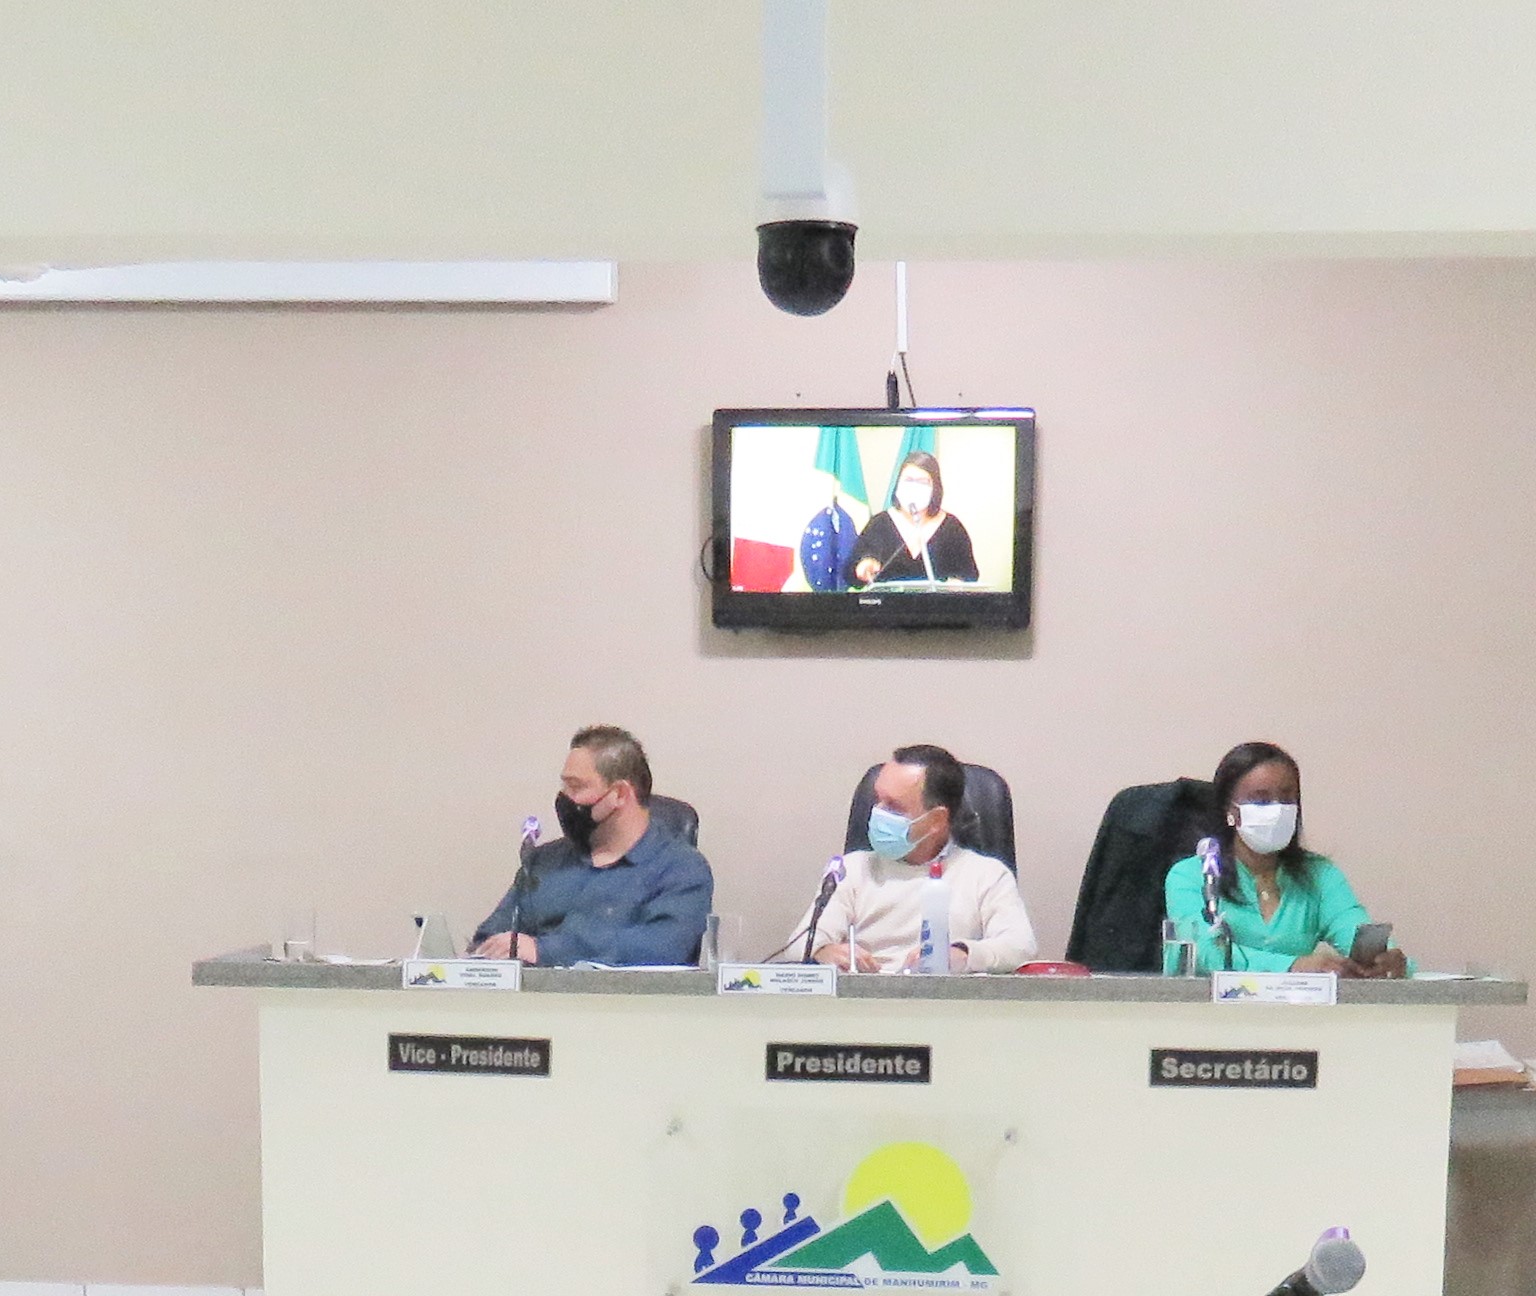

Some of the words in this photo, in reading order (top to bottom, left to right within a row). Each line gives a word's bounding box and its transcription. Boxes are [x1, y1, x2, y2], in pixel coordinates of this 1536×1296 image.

[399, 1043, 436, 1063] Vice
[450, 1044, 541, 1068] Presidente
[776, 1052, 921, 1075] Presidente
[1161, 1057, 1309, 1081] Secretário
[864, 1277, 879, 1286] DE
[970, 1280, 989, 1290] MG
